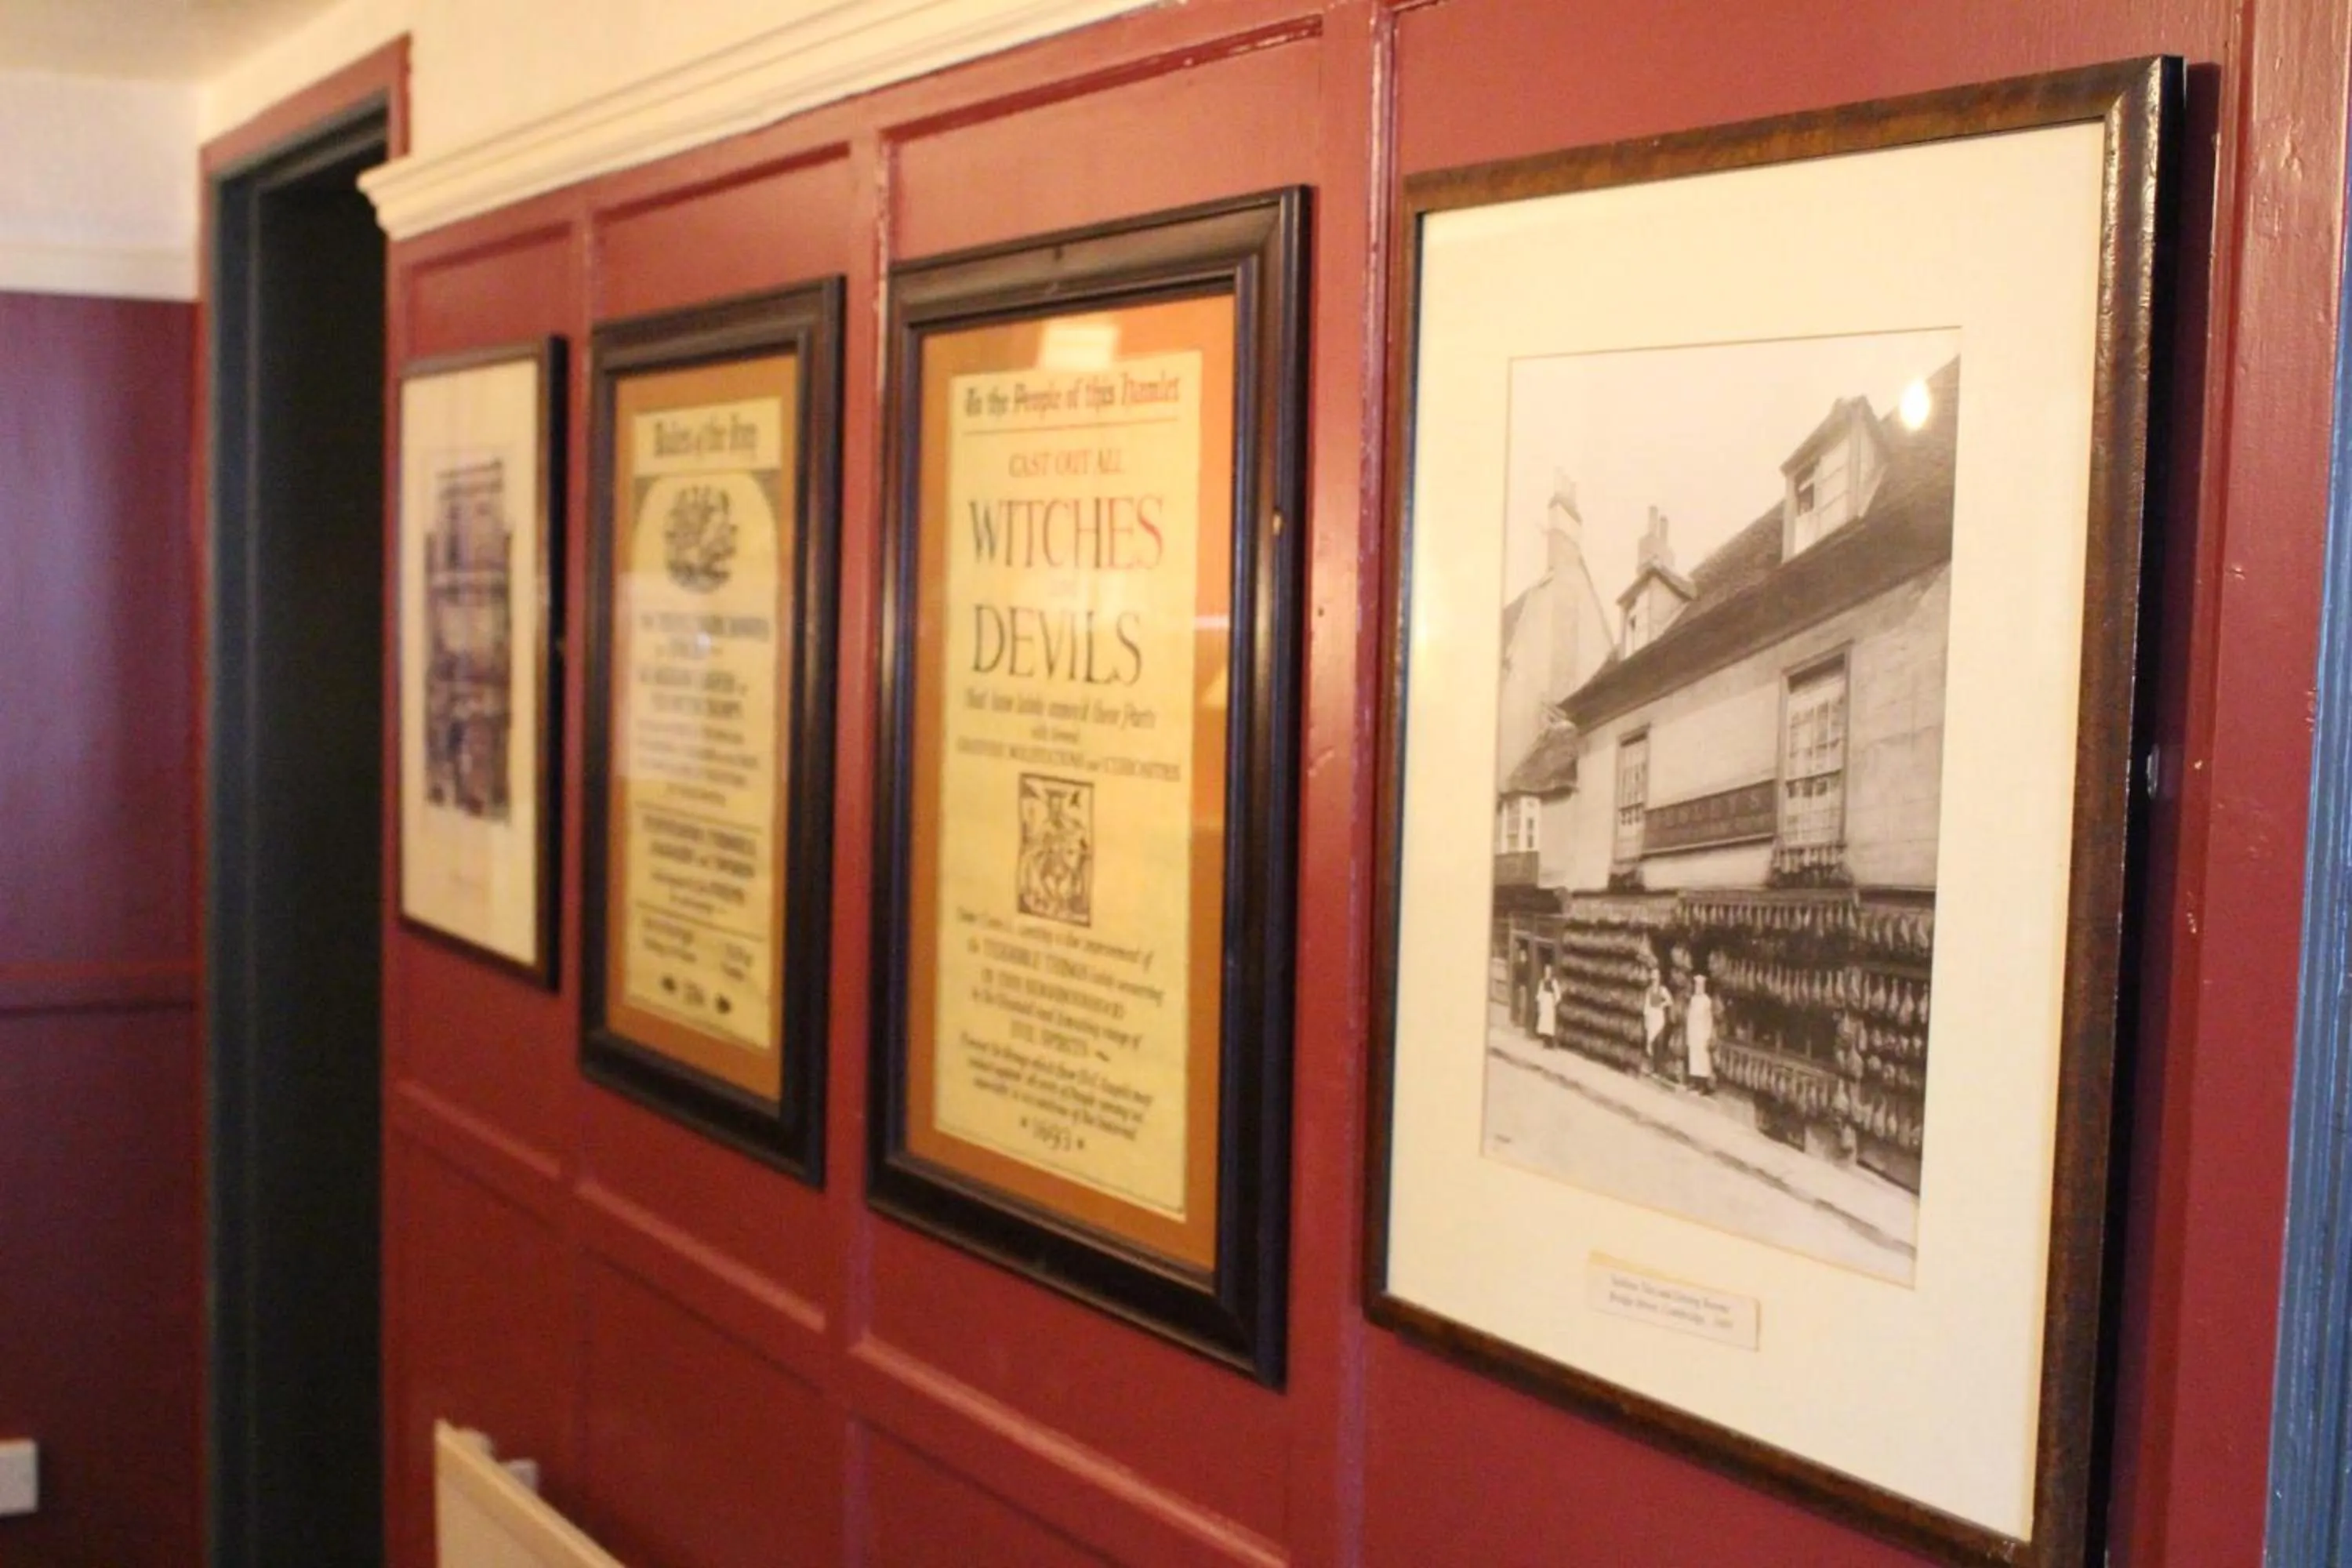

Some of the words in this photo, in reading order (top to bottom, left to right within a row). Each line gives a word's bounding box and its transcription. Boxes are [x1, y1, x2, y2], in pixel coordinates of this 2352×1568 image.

[987, 385, 1010, 419] the
[1013, 380, 1061, 419] People
[1066, 376, 1083, 409] of
[1085, 376, 1114, 412] this
[1120, 369, 1181, 407] Hamlet
[1008, 451, 1049, 478] CAST
[1054, 448, 1090, 477] OUT
[1096, 448, 1123, 474] ALL
[967, 494, 1165, 571] WITCHES
[970, 601, 1143, 686] DEVILS
